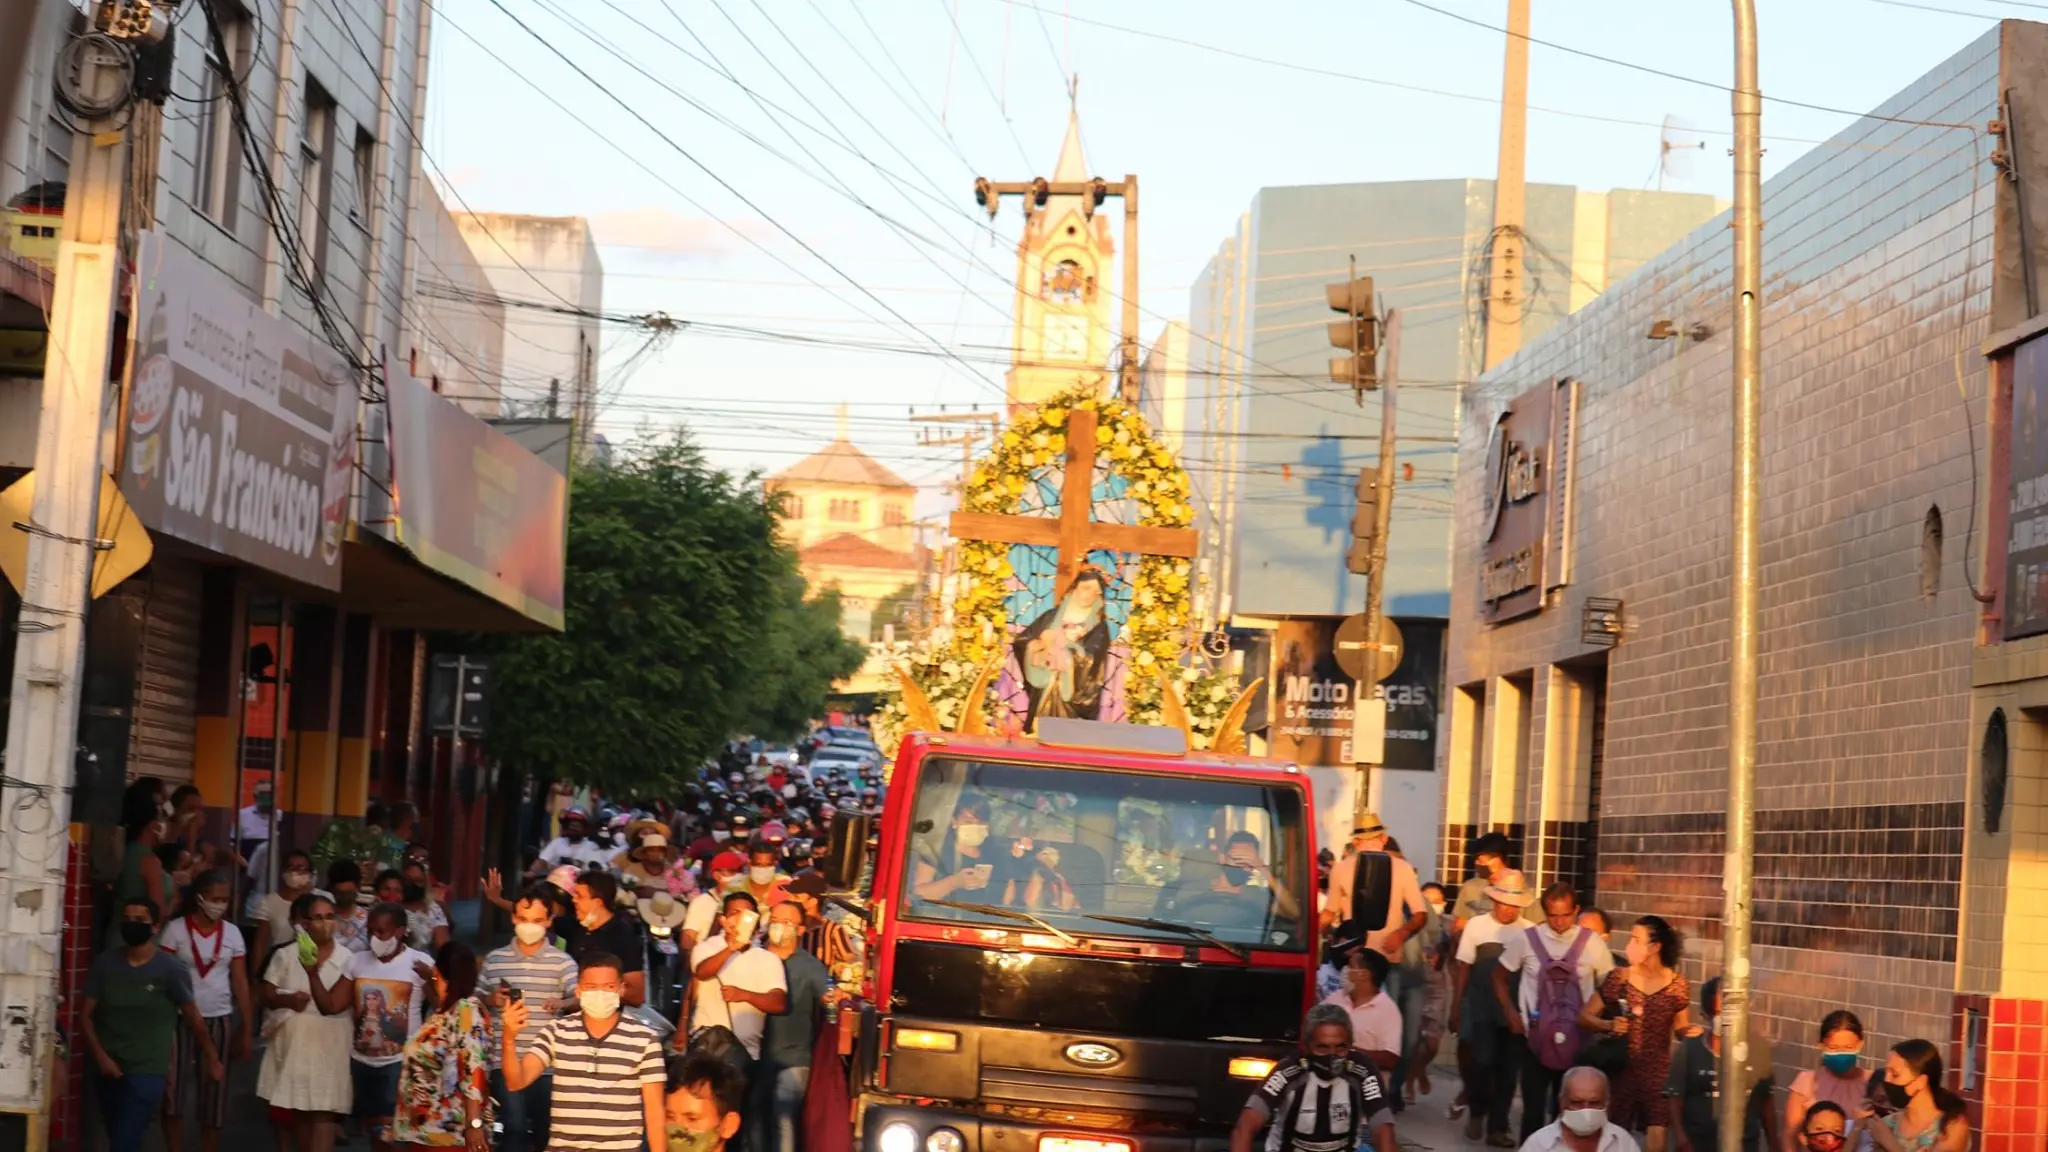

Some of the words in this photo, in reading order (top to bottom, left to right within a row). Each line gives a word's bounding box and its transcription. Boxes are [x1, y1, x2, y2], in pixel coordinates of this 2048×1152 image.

[165, 386, 211, 517] São
[212, 410, 319, 559] Francisco
[1286, 674, 1348, 703] Moto
[1297, 704, 1354, 719] Acessório
